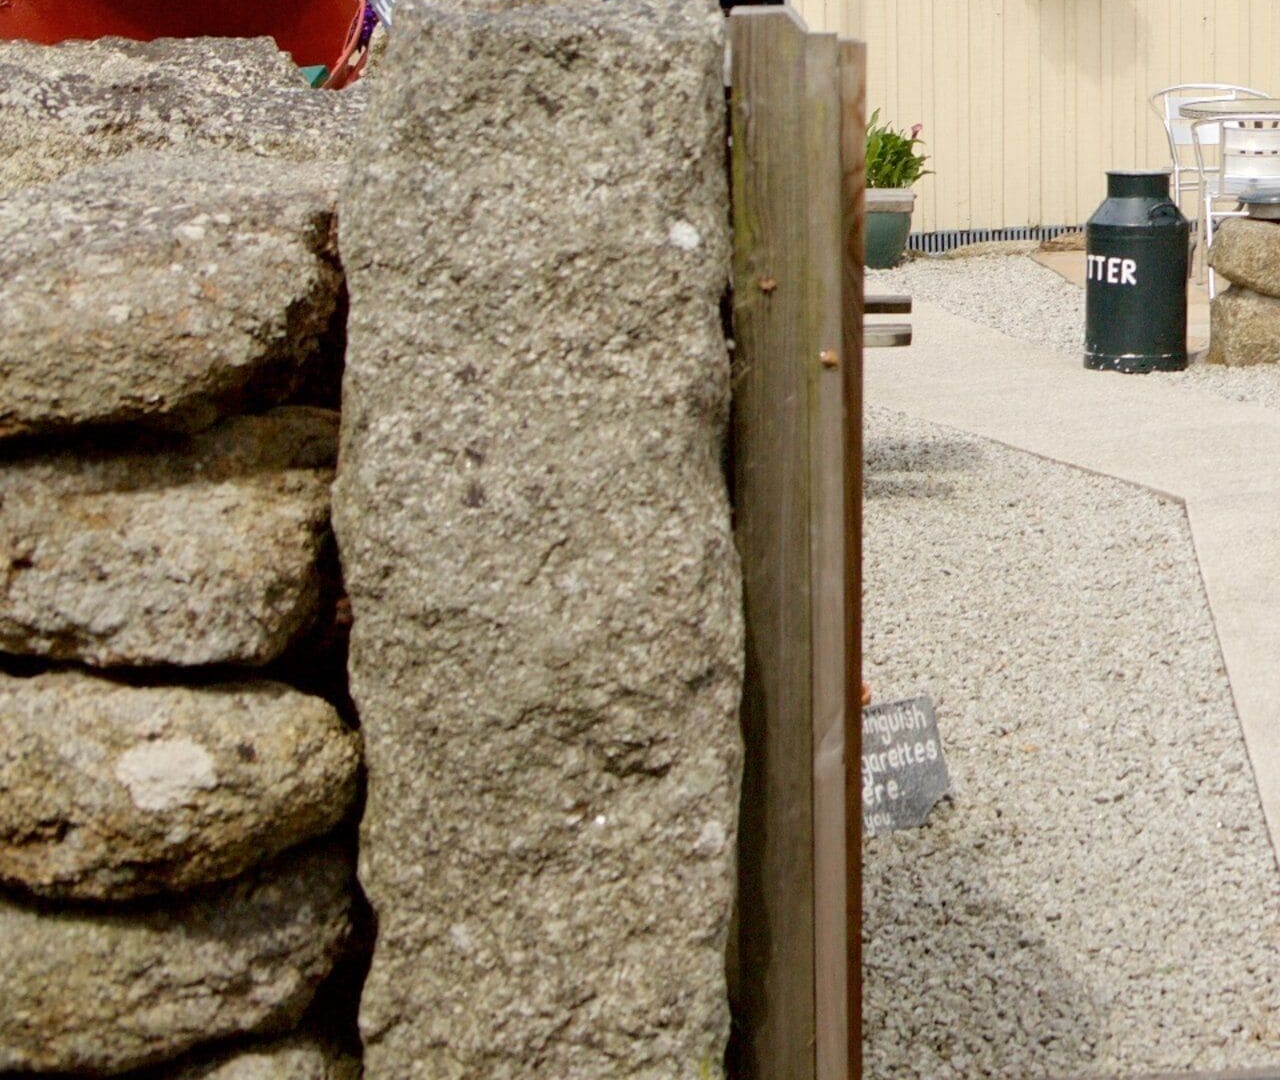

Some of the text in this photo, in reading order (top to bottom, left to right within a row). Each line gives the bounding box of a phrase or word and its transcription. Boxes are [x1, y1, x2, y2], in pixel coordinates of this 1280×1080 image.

[1087, 254, 1137, 286] TTER
[861, 739, 937, 786] garettes
[862, 780, 905, 806] ere.
